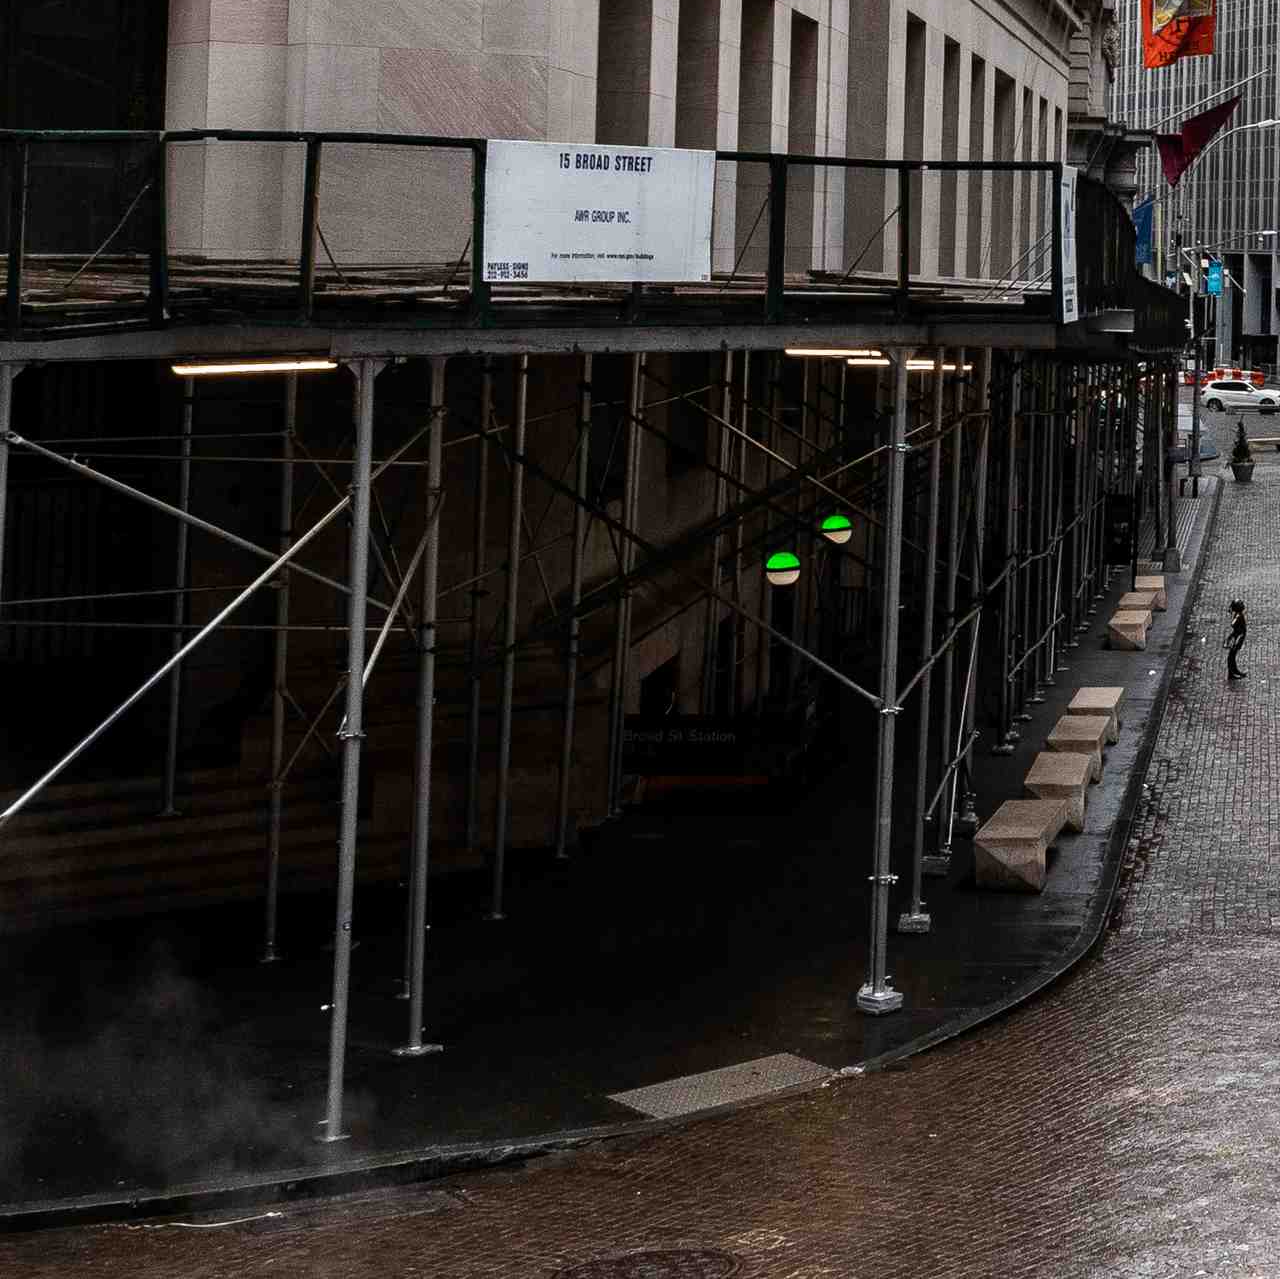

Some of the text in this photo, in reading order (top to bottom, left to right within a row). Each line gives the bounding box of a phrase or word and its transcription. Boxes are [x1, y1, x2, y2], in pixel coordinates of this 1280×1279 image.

[559, 153, 653, 172] 15 BROAD STREET
[592, 210, 615, 223] GROUP
[687, 729, 736, 745] Station
